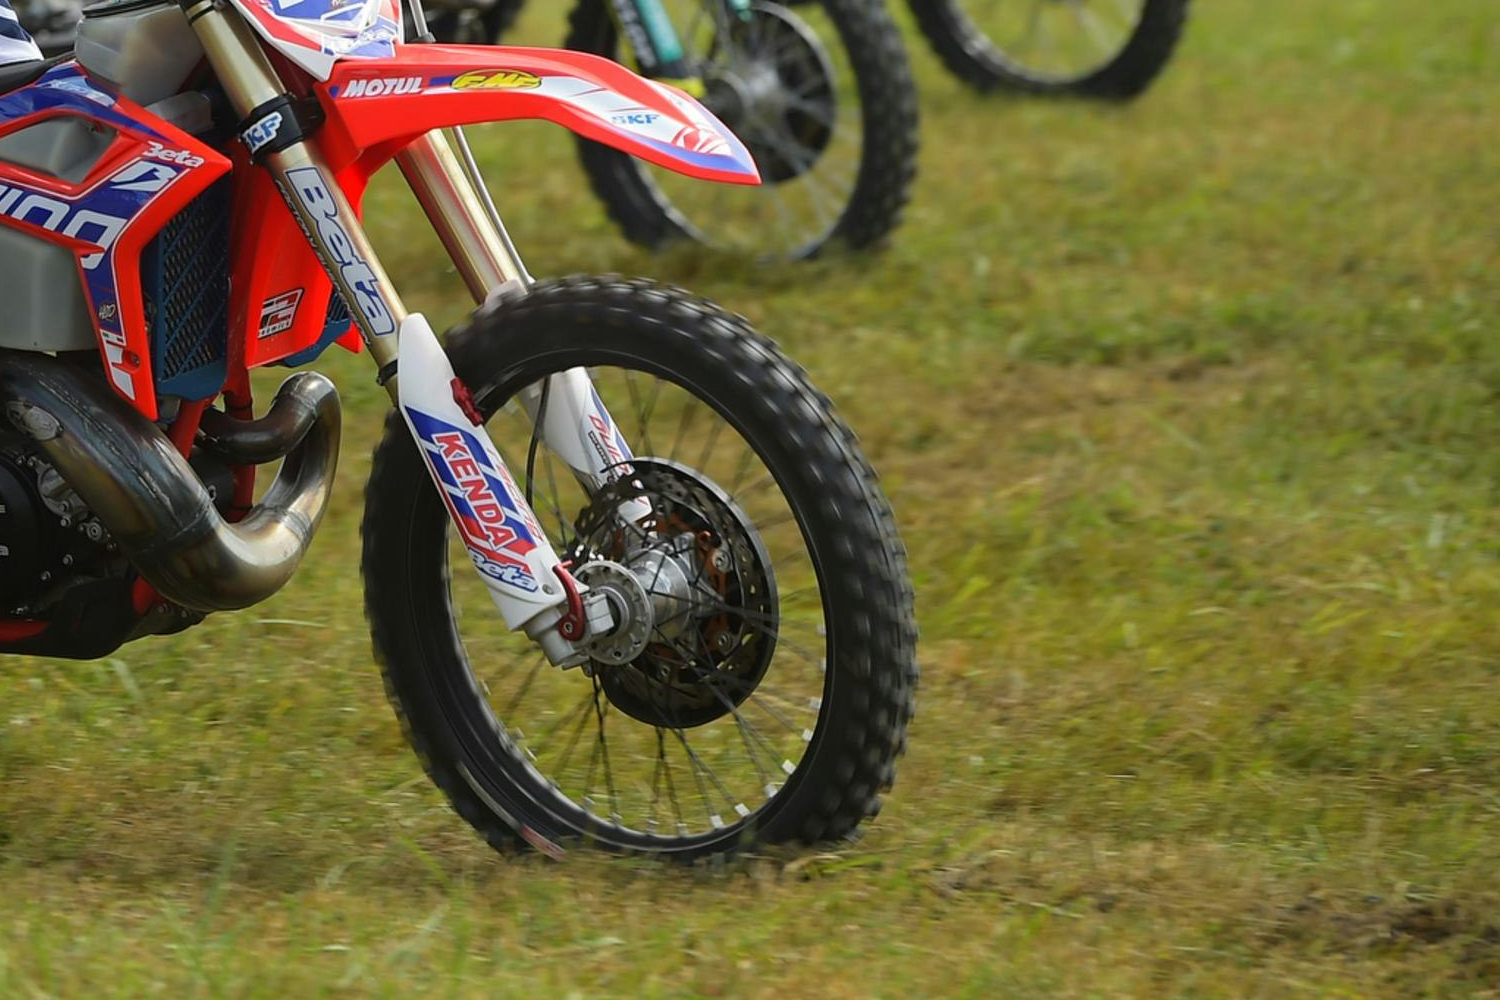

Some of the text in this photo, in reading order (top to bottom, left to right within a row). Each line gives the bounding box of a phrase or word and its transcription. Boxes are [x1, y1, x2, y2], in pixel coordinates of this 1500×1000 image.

[341, 76, 423, 98] MOTUL
[453, 72, 541, 89] FMF
[246, 114, 279, 148] KF
[612, 114, 660, 124] SKF
[285, 167, 395, 336] Beta
[433, 433, 517, 549] KENDA
[468, 547, 539, 592] Beta
